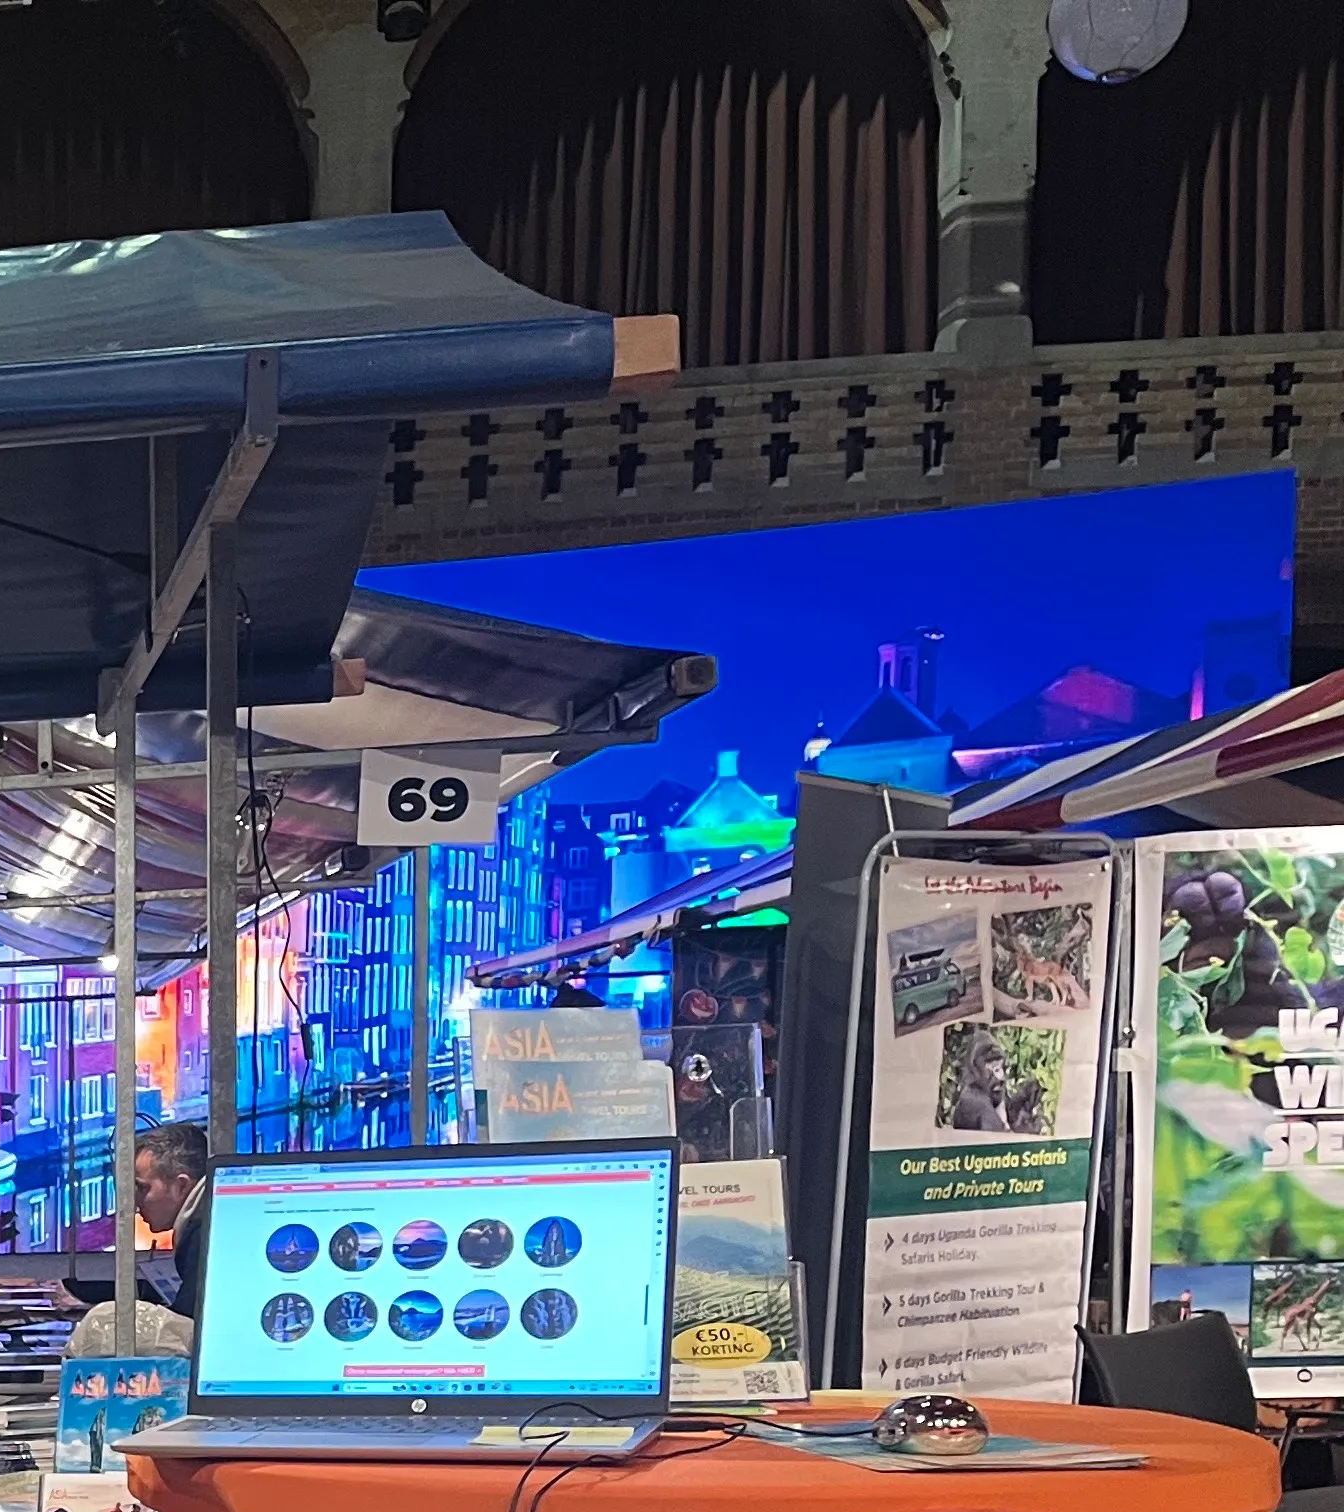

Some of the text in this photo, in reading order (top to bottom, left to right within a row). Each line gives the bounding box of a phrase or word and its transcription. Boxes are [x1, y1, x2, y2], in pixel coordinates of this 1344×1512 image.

[387, 777, 469, 822] 69
[482, 1019, 557, 1061] ASIA
[498, 1073, 574, 1115] ASIA
[900, 1147, 1067, 1176] Our Best Uganda Safaris
[702, 1184, 741, 1194] TOURS
[924, 1178, 1044, 1201] and Private Tours
[902, 1232, 909, 1244] 4
[912, 1230, 935, 1245] days
[938, 1227, 977, 1243] Uganda
[979, 1224, 1014, 1238] Gorilla
[901, 1251, 935, 1265] Safaris
[899, 1294, 905, 1307] 5
[908, 1293, 931, 1308] days
[933, 1289, 966, 1304] Gorilla
[970, 1286, 1014, 1300] Trekking
[692, 1343, 754, 1356] KORTING
[904, 1354, 925, 1369] days
[928, 1351, 963, 1366] Budget
[965, 1346, 1009, 1362] Friendly
[904, 1375, 934, 1390] Gorilla
